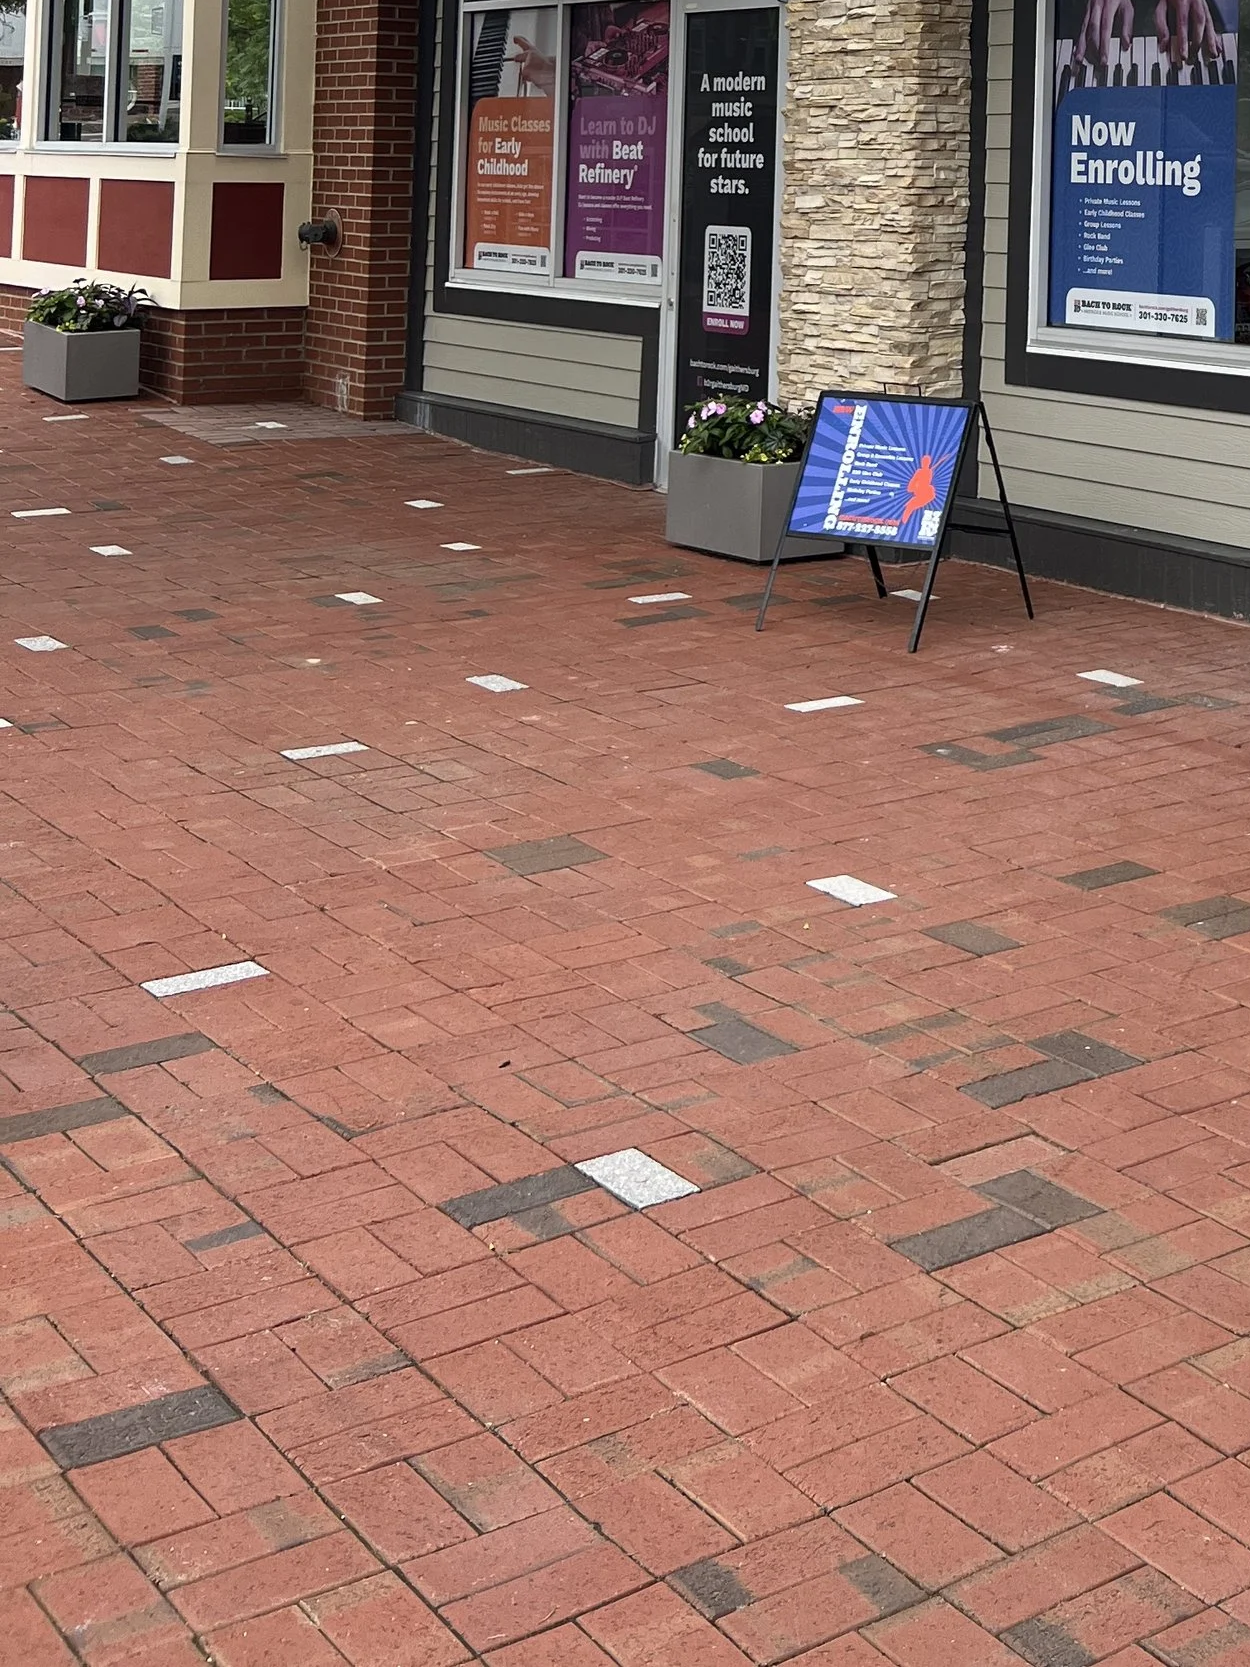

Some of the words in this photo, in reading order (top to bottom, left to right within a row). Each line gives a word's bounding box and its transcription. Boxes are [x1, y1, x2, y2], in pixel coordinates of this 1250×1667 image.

[700, 74, 710, 92] A
[713, 71, 766, 92] modern
[712, 96, 752, 117] music
[479, 115, 508, 133] Music
[511, 115, 551, 133] Classes
[580, 117, 617, 135] Learn
[620, 116, 634, 135] to
[638, 115, 657, 135] DJ
[709, 122, 754, 143] school
[1071, 114, 1136, 146] Now
[478, 137, 493, 154] for
[495, 137, 521, 159] Early
[580, 139, 609, 159] with
[612, 140, 643, 160] Beat
[698, 147, 718, 168] for
[720, 147, 764, 169] future
[477, 158, 528, 176] Childhood
[1070, 150, 1202, 197] Enrolling
[710, 175, 749, 194] stars.
[1084, 209, 1097, 217] Early
[1084, 220, 1099, 229] Group
[1083, 255, 1104, 265] Birthday
[1105, 256, 1123, 264] Parties
[1081, 300, 1101, 309] BACH
[1101, 301, 1111, 310] TO
[1112, 302, 1132, 312] ROCK
[706, 317, 729, 328] ENROLL
[729, 319, 745, 330] NOW
[1138, 310, 1188, 323] 301-330-7625
[823, 404, 867, 530] ENROLLING
